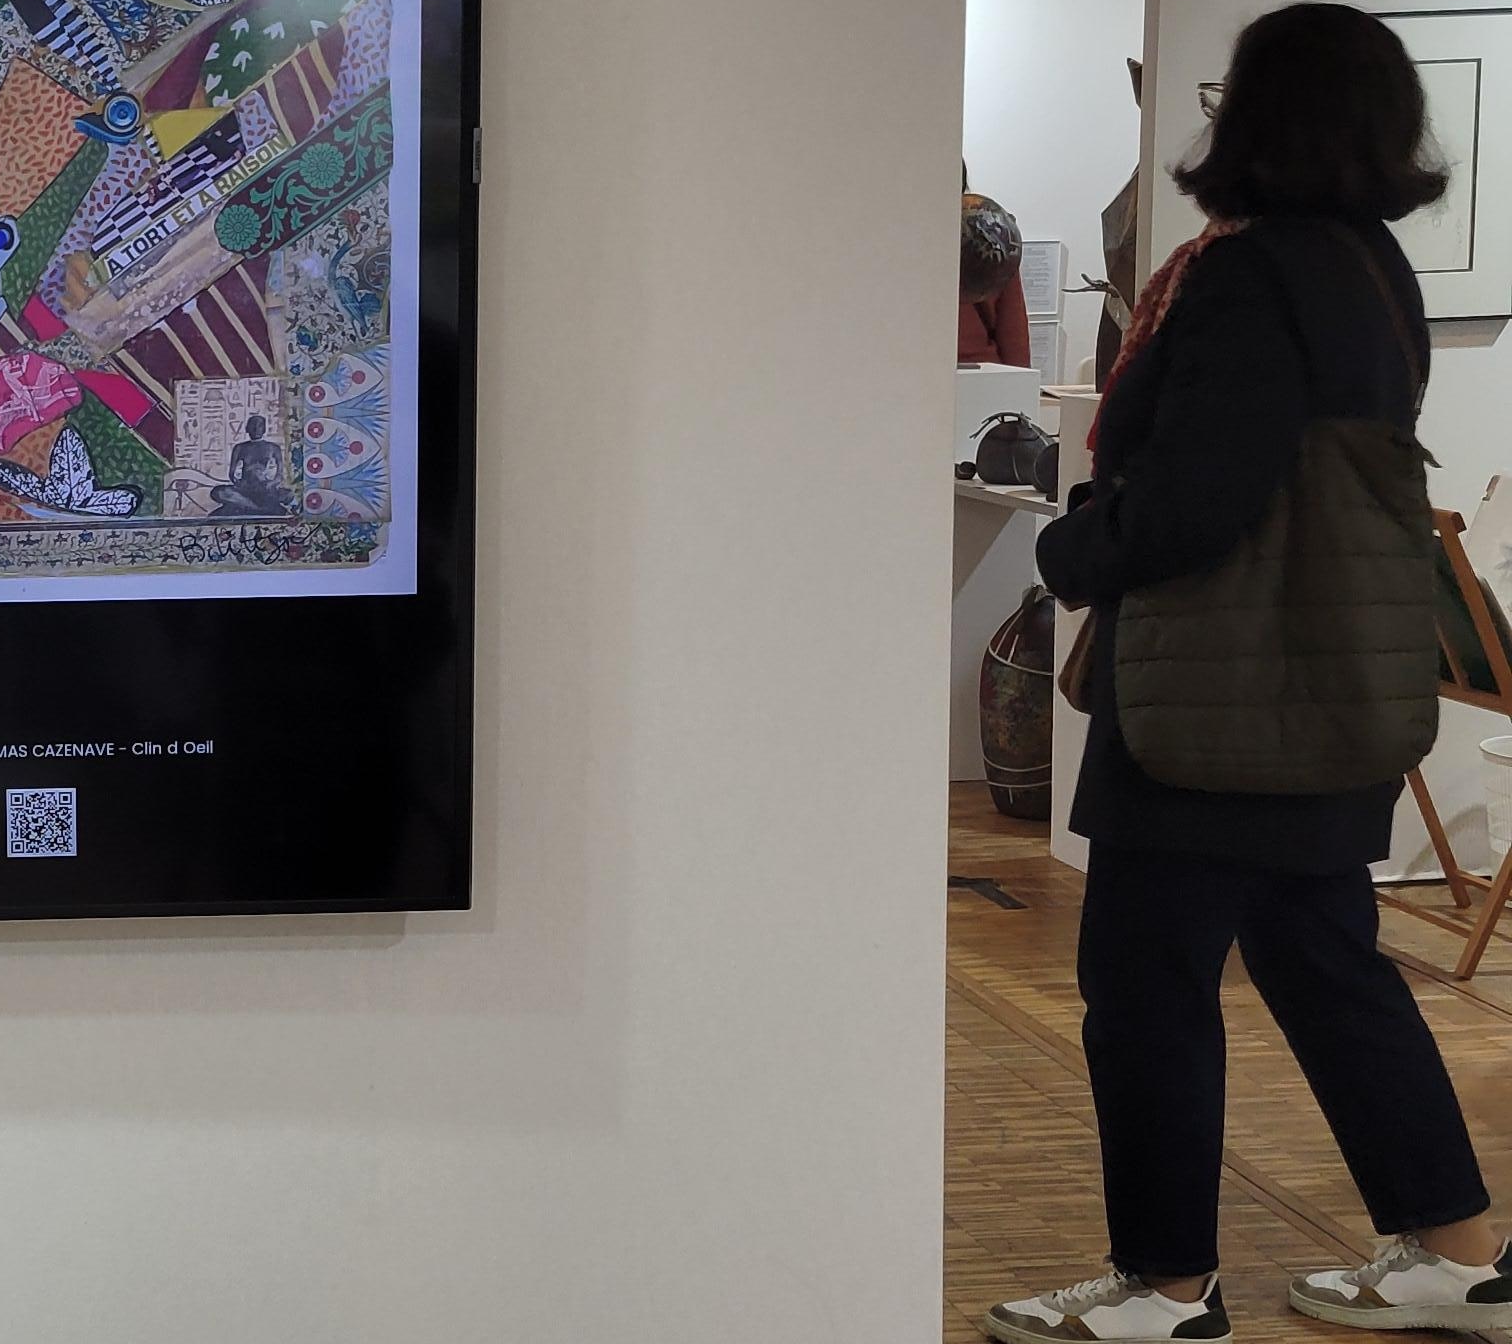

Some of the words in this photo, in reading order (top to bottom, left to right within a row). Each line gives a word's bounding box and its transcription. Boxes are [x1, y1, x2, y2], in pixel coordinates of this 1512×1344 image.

[120, 218, 173, 262] TORT
[173, 203, 195, 225] ET
[215, 134, 288, 195] RAISON
[32, 742, 115, 758] CAZENAVE
[131, 741, 162, 756] Clin
[167, 740, 178, 755] d
[183, 739, 214, 754] Oeil
